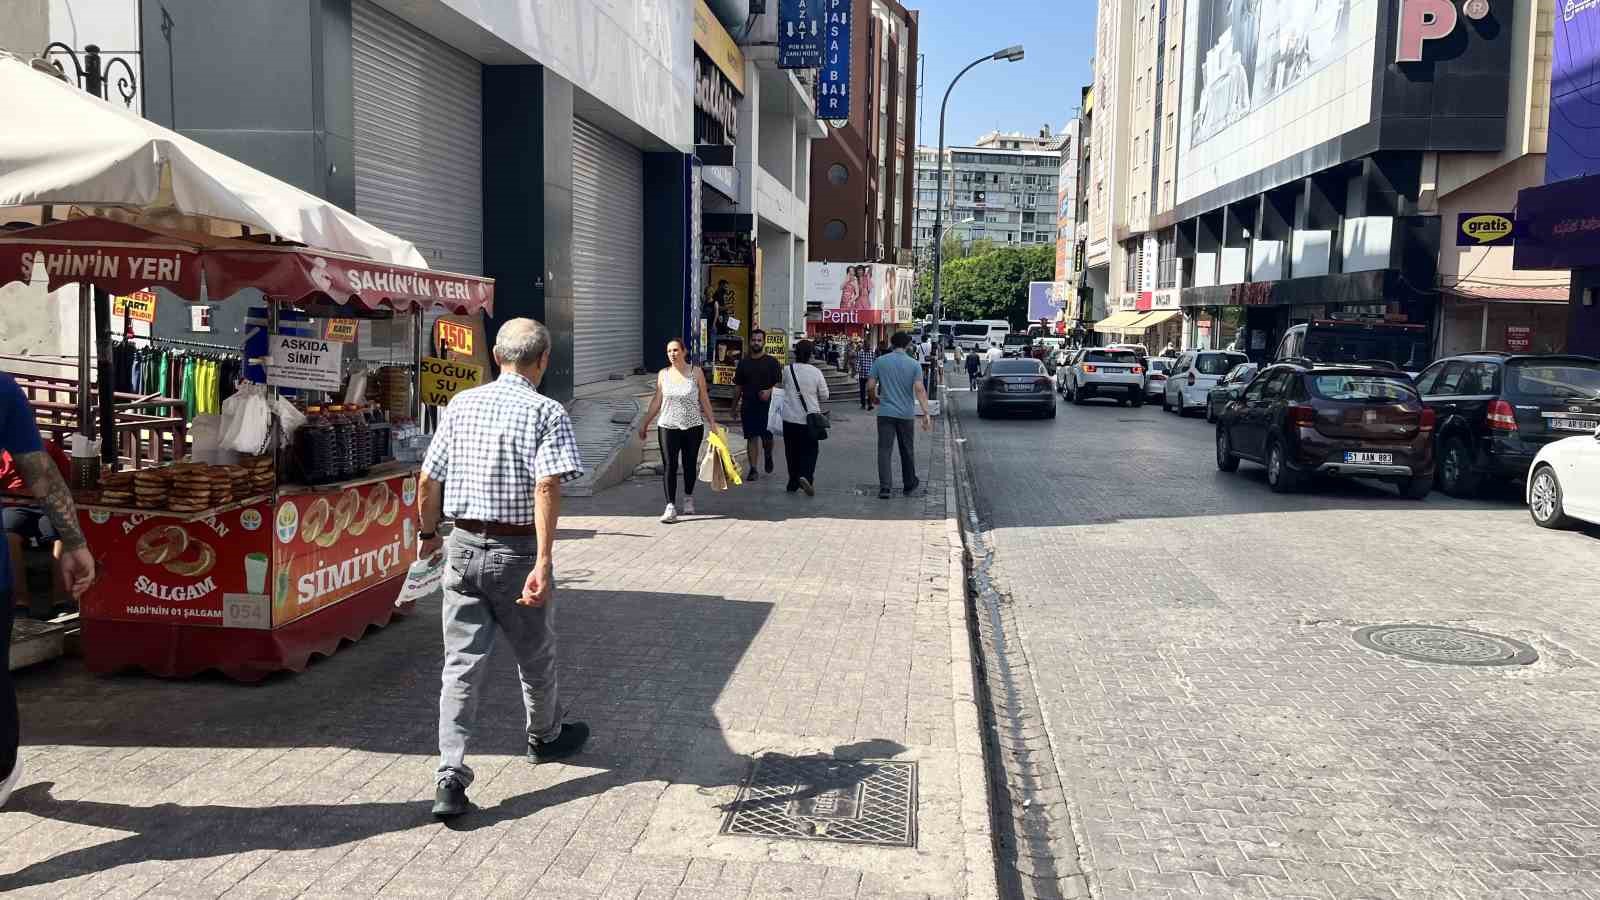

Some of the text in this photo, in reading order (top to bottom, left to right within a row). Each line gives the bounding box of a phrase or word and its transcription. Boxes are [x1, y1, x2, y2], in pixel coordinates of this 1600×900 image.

[830, 0, 840, 64] PASAJ
[1468, 218, 1508, 233] gratis
[21, 249, 183, 281] ŞHİN'İN YERİ
[434, 279, 472, 300] YERİ
[822, 309, 858, 323] Penti
[281, 339, 328, 352] ASKIDA
[287, 352, 321, 365] SİMİT
[421, 361, 478, 382] SOĞUK
[436, 379, 457, 392] SU
[298, 533, 401, 605] SİMİTÇİ
[134, 574, 218, 601] ŞALGAM
